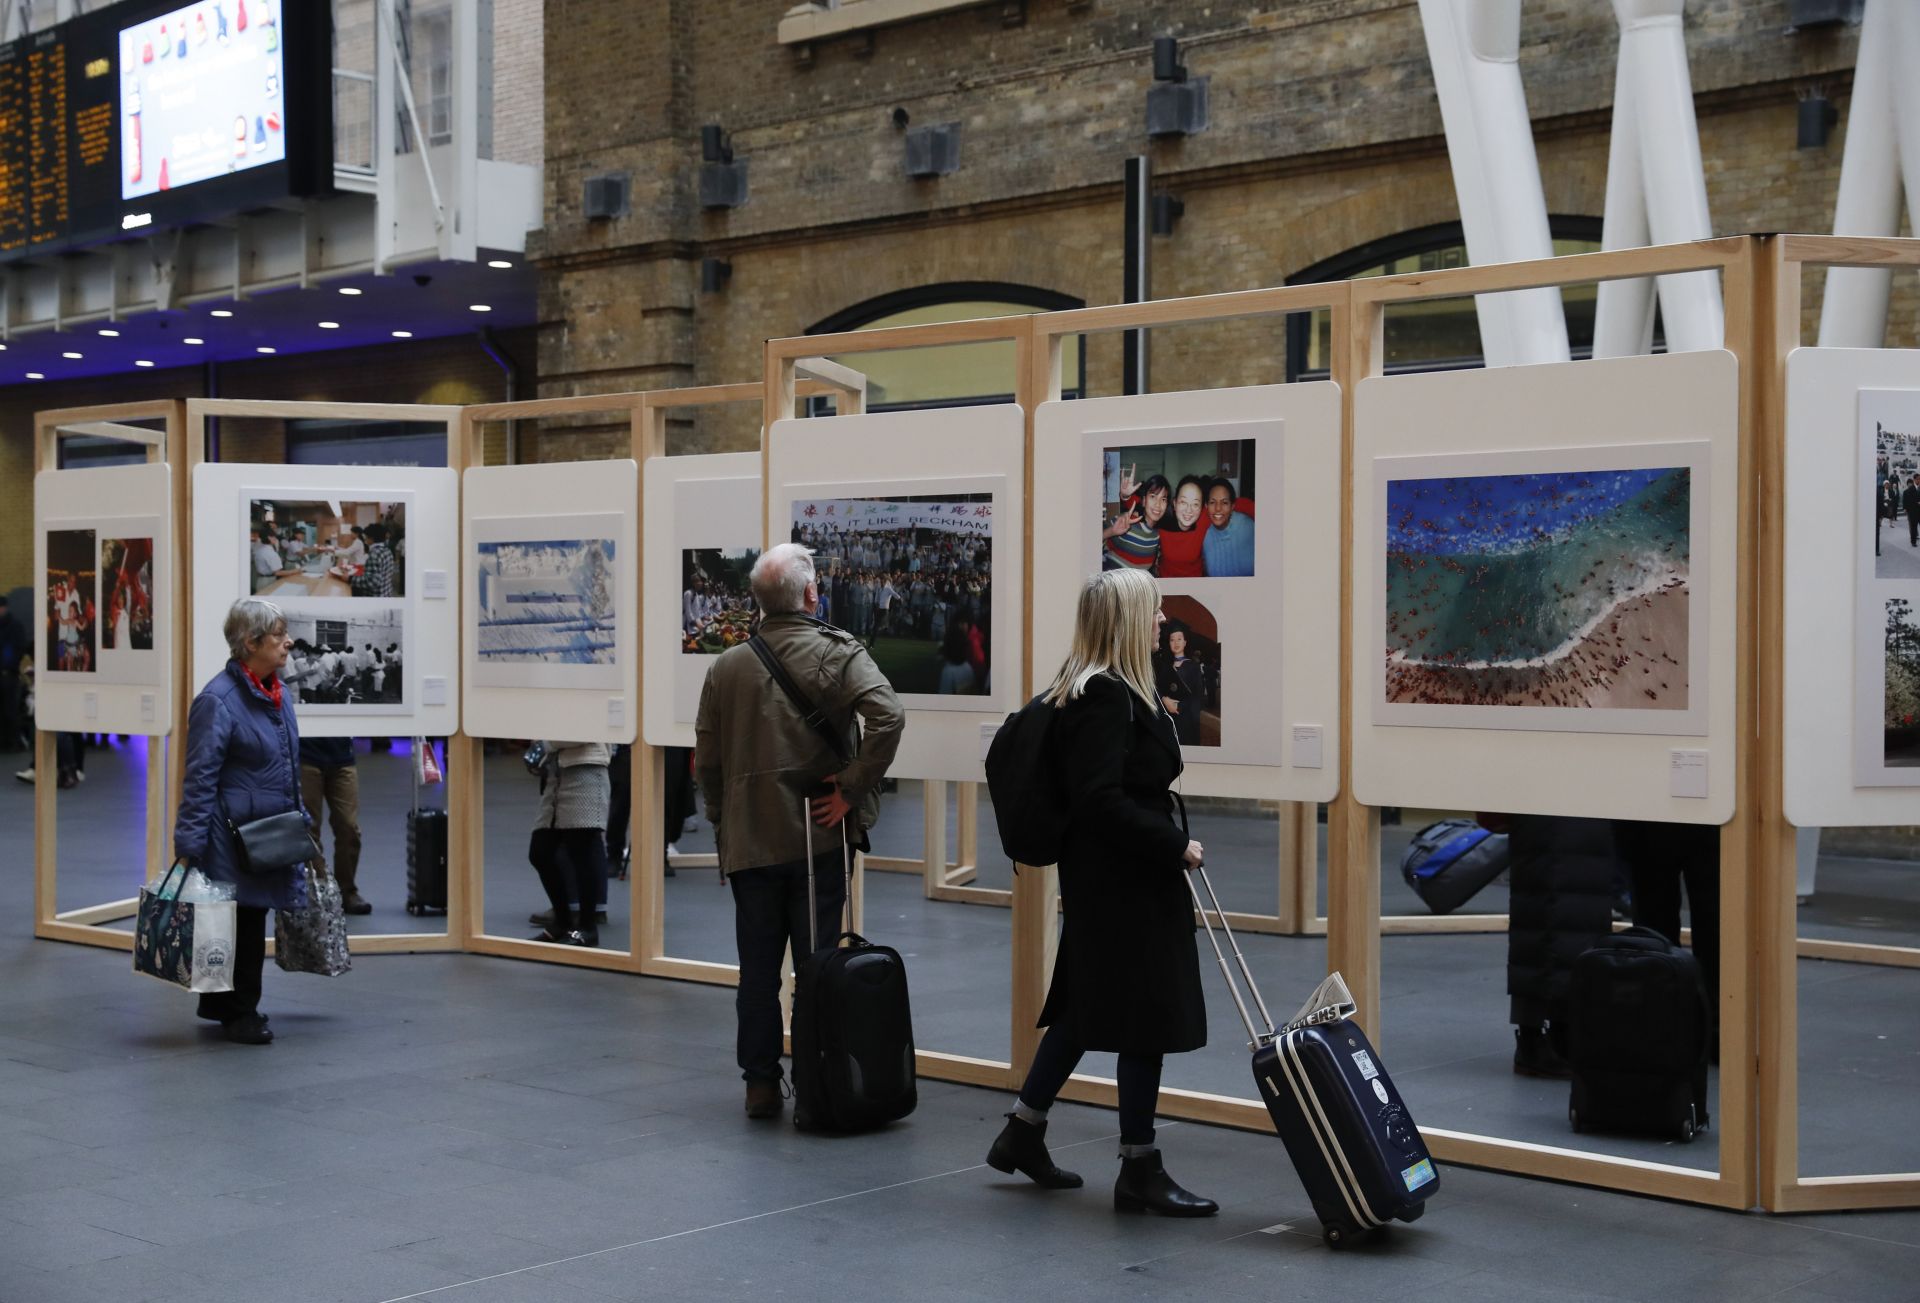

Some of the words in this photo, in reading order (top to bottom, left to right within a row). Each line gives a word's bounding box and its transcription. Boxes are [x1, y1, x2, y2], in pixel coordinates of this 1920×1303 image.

[848, 519, 861, 527] IT
[868, 516, 899, 526] LIKE
[909, 516, 989, 530] BECKHAM
